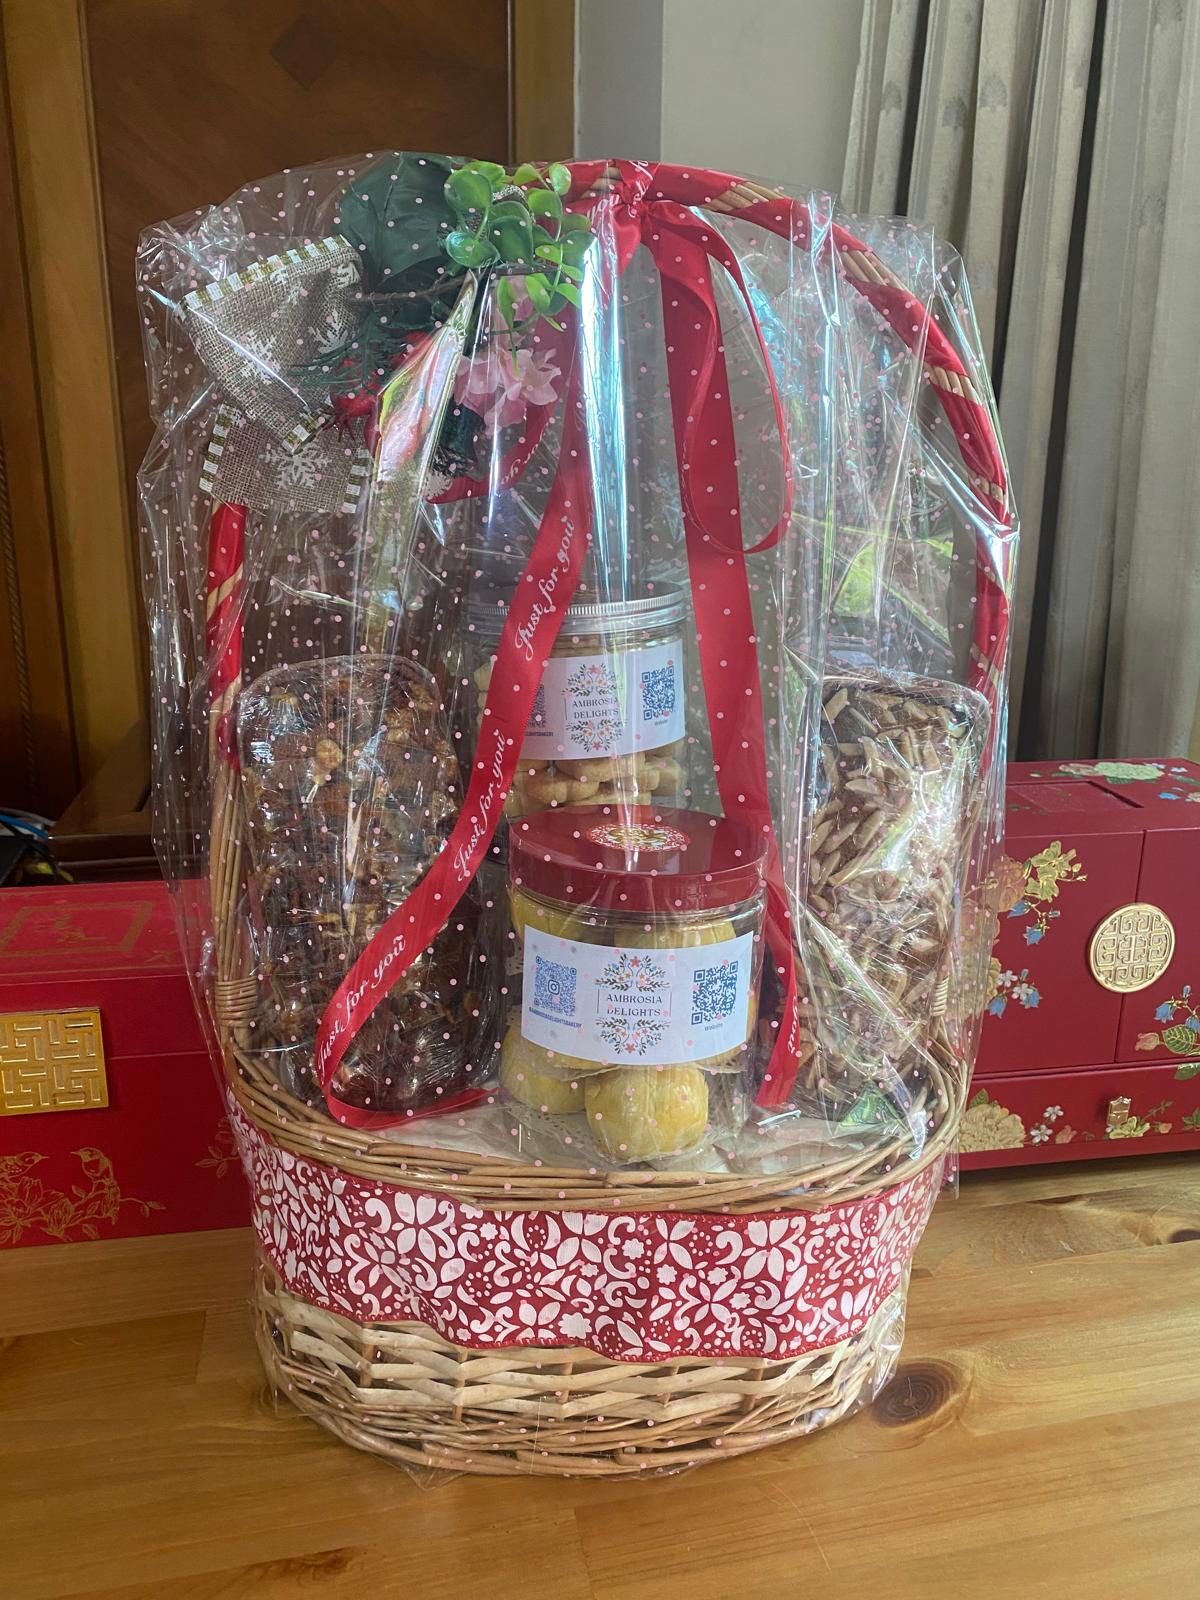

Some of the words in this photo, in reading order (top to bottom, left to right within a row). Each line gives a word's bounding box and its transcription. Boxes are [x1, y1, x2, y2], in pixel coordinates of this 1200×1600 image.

[514, 602, 545, 662] Just
[538, 566, 558, 613] for
[556, 518, 576, 573] you
[572, 697, 618, 708] AMBROSIA
[573, 709, 619, 720] DELIGHTS
[453, 822, 483, 882] Just
[479, 782, 494, 835] for
[491, 732, 507, 789] you
[339, 978, 369, 1034] for
[371, 936, 407, 989] you
[606, 993, 663, 1004] AMBROSIA
[606, 1006, 662, 1018] DELIGHTS
